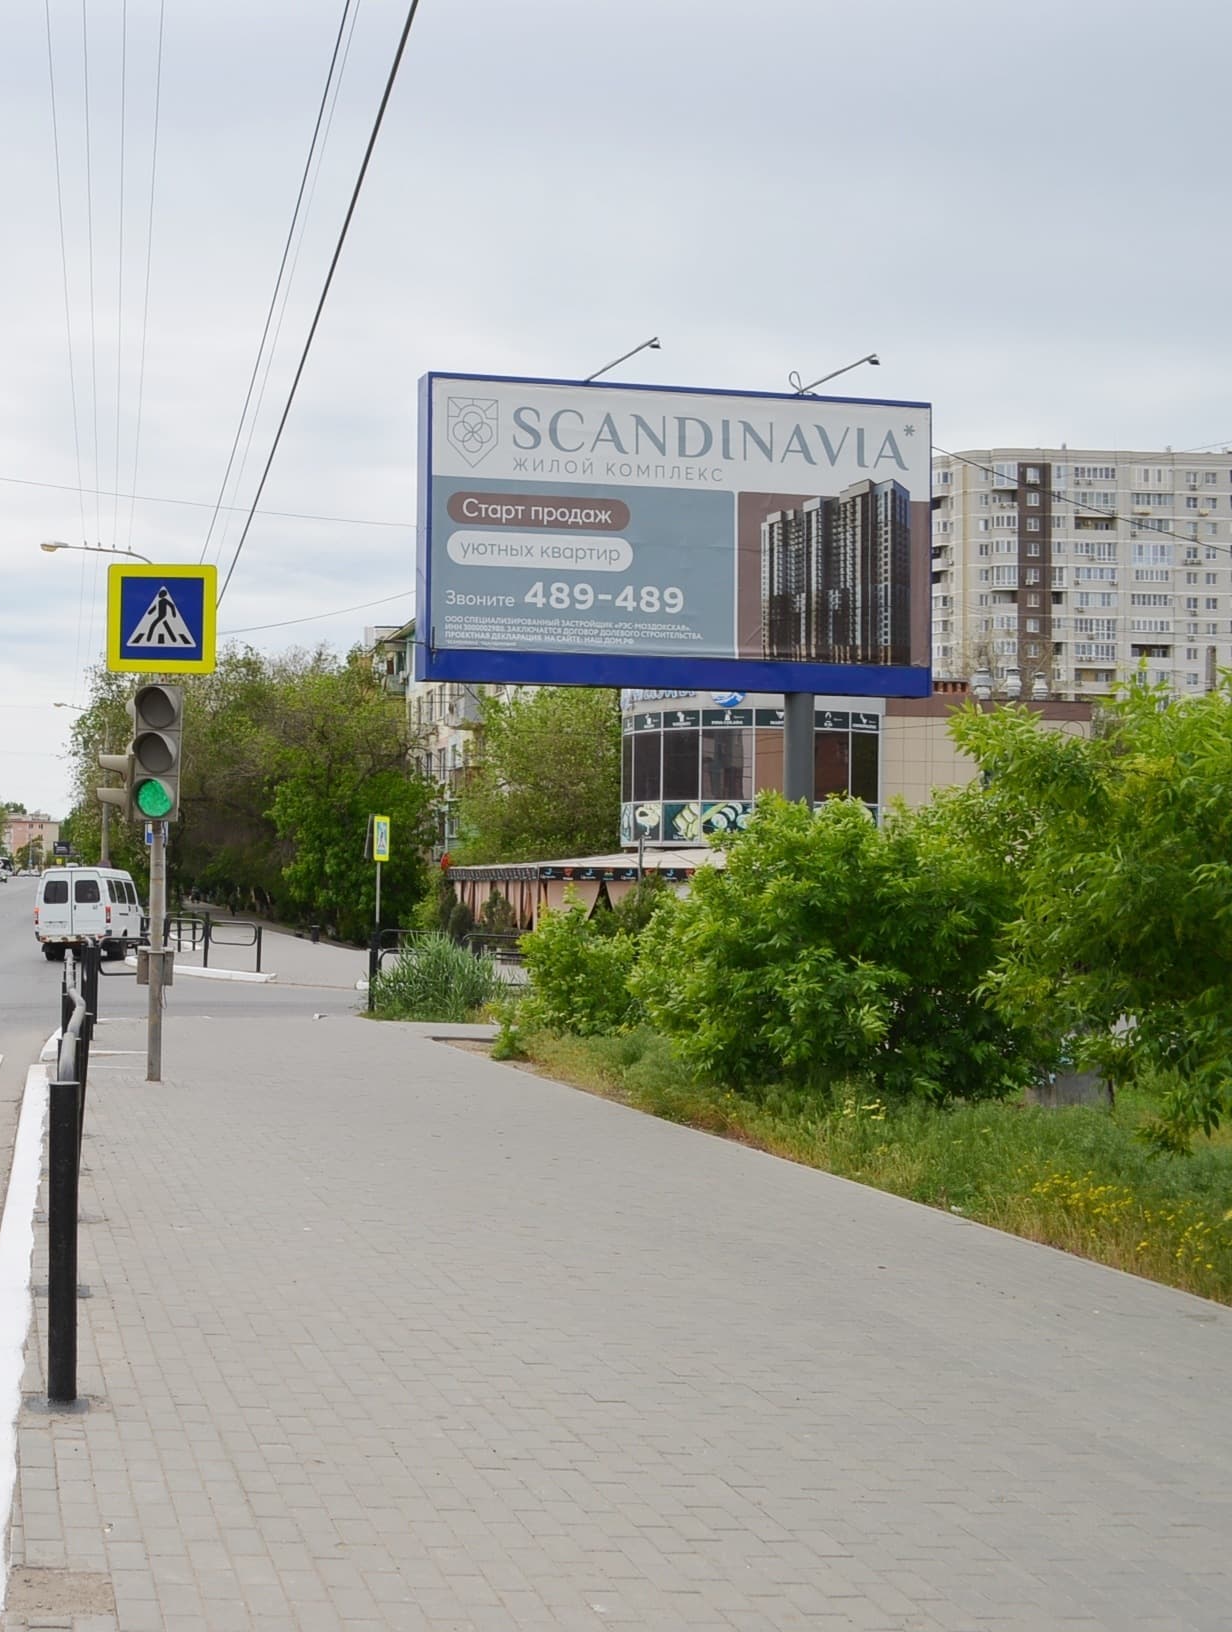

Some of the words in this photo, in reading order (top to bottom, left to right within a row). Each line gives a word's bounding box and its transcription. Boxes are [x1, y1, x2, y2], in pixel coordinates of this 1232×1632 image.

[512, 457, 594, 475] ЖИЛОЙ
[606, 463, 723, 482] КОМПЛЕКС
[462, 498, 525, 524] Старт
[531, 505, 612, 525] продаж
[460, 540, 534, 559] уютных
[540, 544, 621, 566] квартир
[445, 589, 515, 607] Звоните
[524, 581, 684, 613] 489-489
[444, 615, 464, 623] ООО
[464, 615, 561, 627] СПЕЦИАЛИЗИРОВАННЫЙ
[506, 625, 562, 634] ЗАКЛЮЧАЕТСЯ
[563, 627, 599, 636] ДОГОВОР
[599, 628, 640, 637] ДОЛЕВОГО
[444, 631, 491, 640] ПРОЕКТНАЯ
